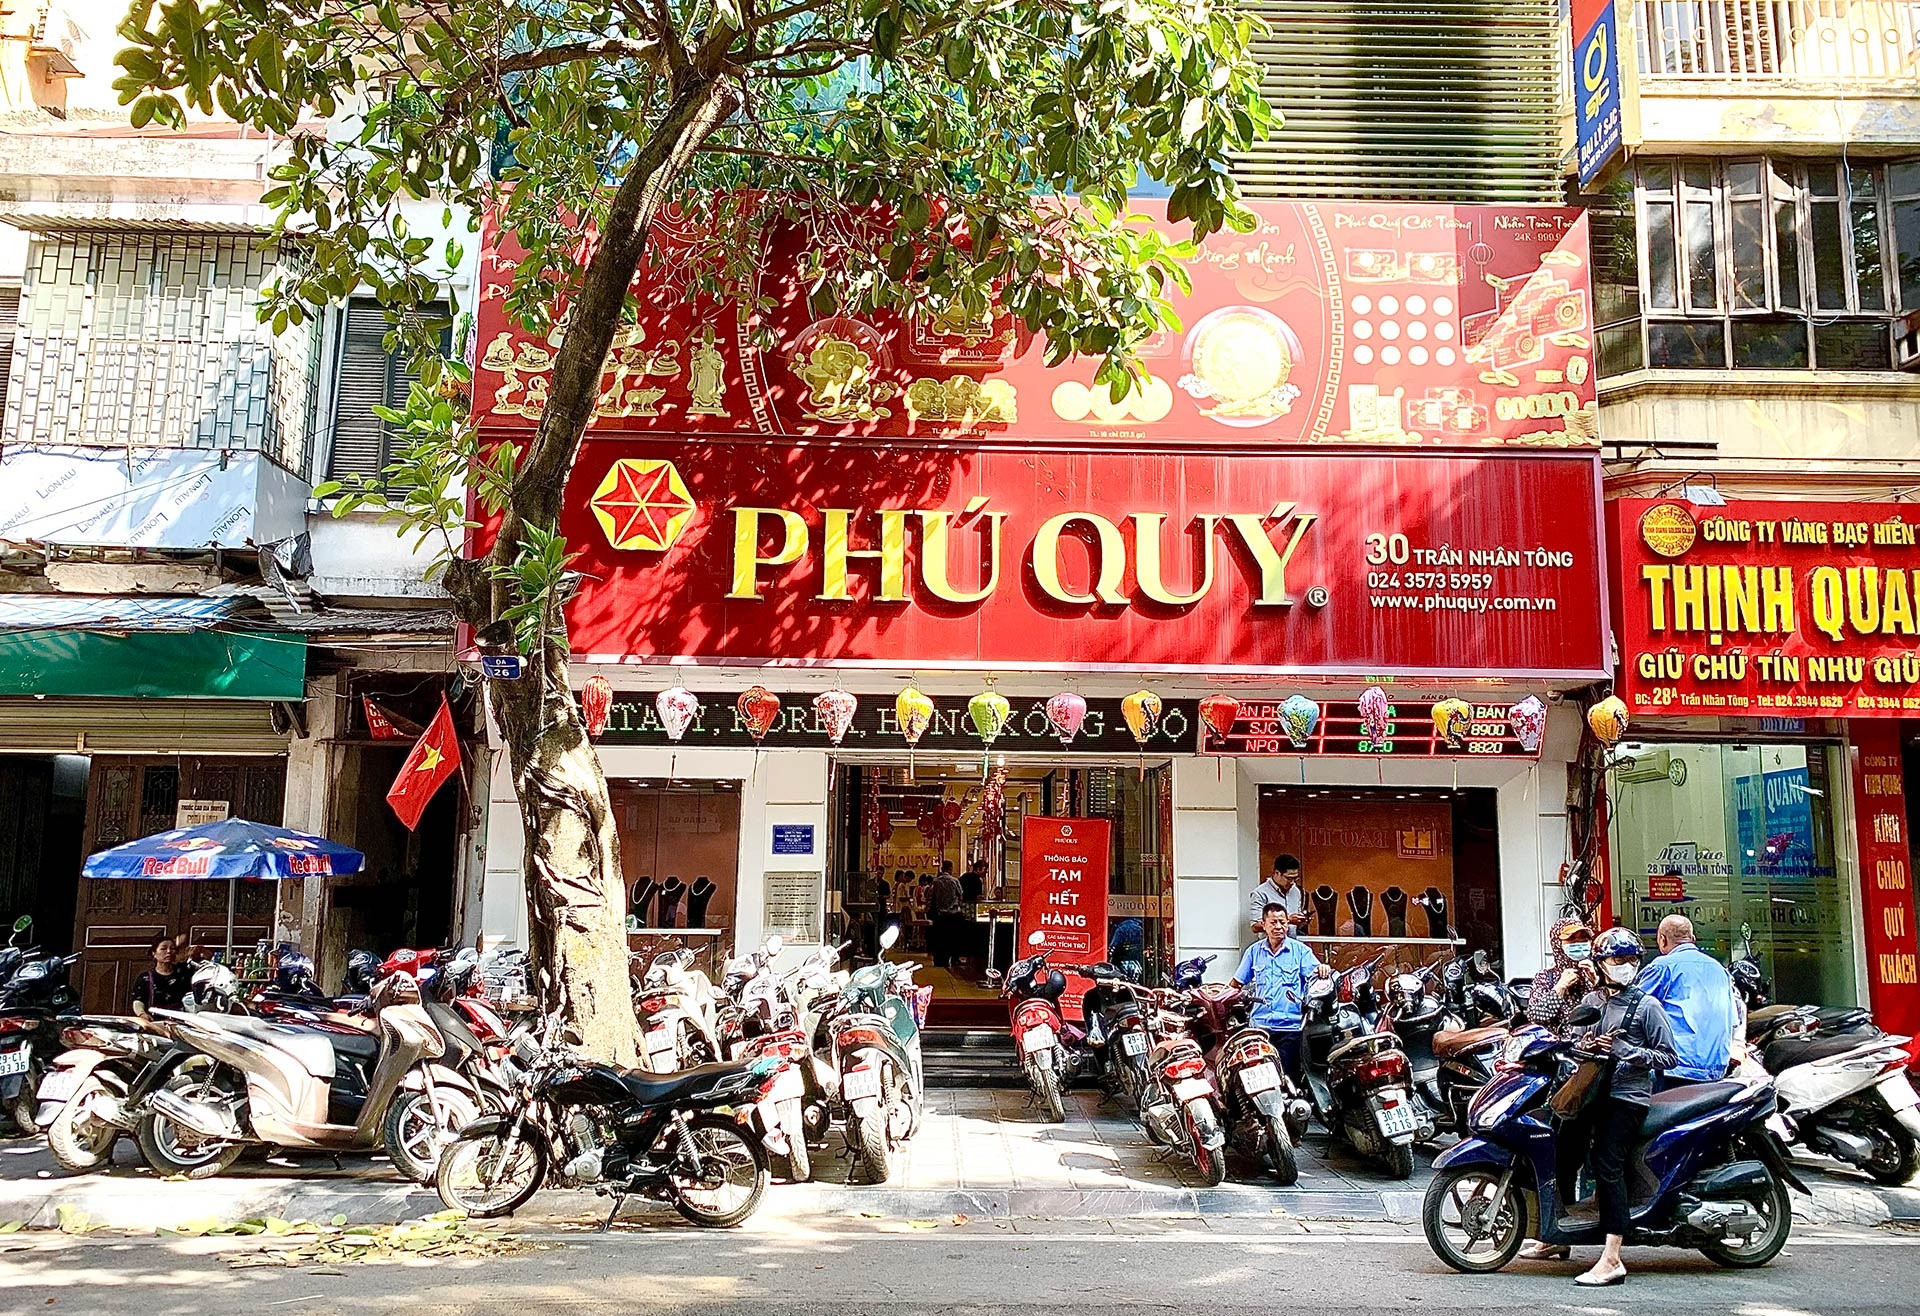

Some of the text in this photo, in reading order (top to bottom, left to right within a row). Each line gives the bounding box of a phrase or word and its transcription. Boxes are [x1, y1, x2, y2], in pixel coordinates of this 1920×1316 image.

[1603, 107, 1618, 135] SJC
[1703, 515, 1917, 549] CÔNG TY VÀNG BẠC HIỀN
[724, 497, 1008, 602] PHÚ
[1033, 501, 1319, 606] QUÝ
[1365, 532, 1574, 568] 30 TRẦN NHÂN TÔNG
[1367, 572, 1493, 590] 024 3573 5959
[1369, 594, 1557, 613] www.phuquy.com.vn
[1641, 564, 1920, 646] THỊNH QUA
[493, 668, 510, 677] 26
[1638, 647, 1687, 680] GIỮ
[1693, 648, 1749, 681] CHỮ
[1757, 649, 1801, 683] TÍN
[1808, 655, 1866, 684] NHƯ
[1634, 693, 1652, 705] ĐC:
[1249, 721, 1278, 735] SJC
[1470, 723, 1506, 736] 8900
[1245, 739, 1280, 752] NPQ
[1873, 809, 1901, 843] KÍNH
[1044, 854, 1088, 864] THÔNG BÁO
[1647, 863, 1658, 875] 28
[1711, 862, 1734, 875] TÔNG
[1049, 868, 1082, 884] TẠM
[1876, 856, 1906, 890] CHÀO
[1048, 888, 1080, 906] HẾT
[1041, 910, 1087, 927] HÀNG
[1884, 902, 1906, 940] QUÝ
[1879, 948, 1918, 985] KHÁCH
